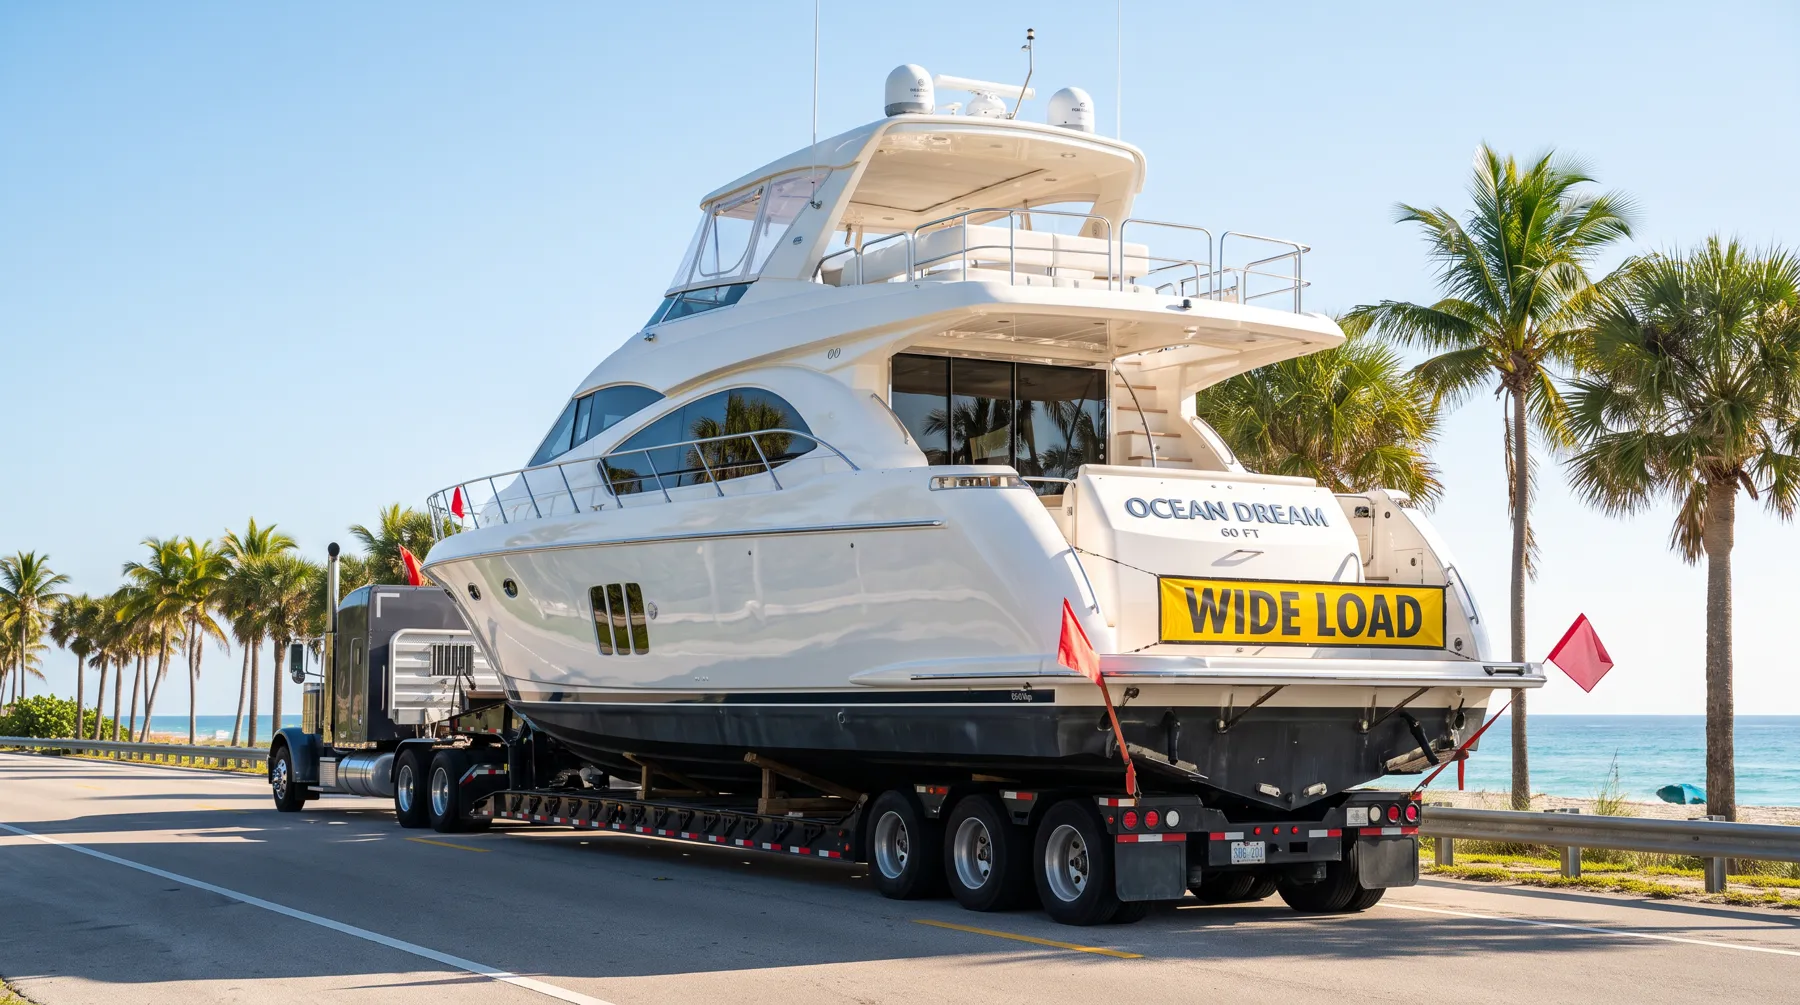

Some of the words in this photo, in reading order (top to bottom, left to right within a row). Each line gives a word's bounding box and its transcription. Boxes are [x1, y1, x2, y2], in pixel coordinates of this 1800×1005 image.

[1124, 497, 1229, 522] OCEAN
[1232, 501, 1330, 528] DREAM
[1220, 527, 1239, 538] 60
[1242, 528, 1259, 539] FT
[1184, 587, 1301, 636] WIDE
[1315, 592, 1422, 638] LOAD
